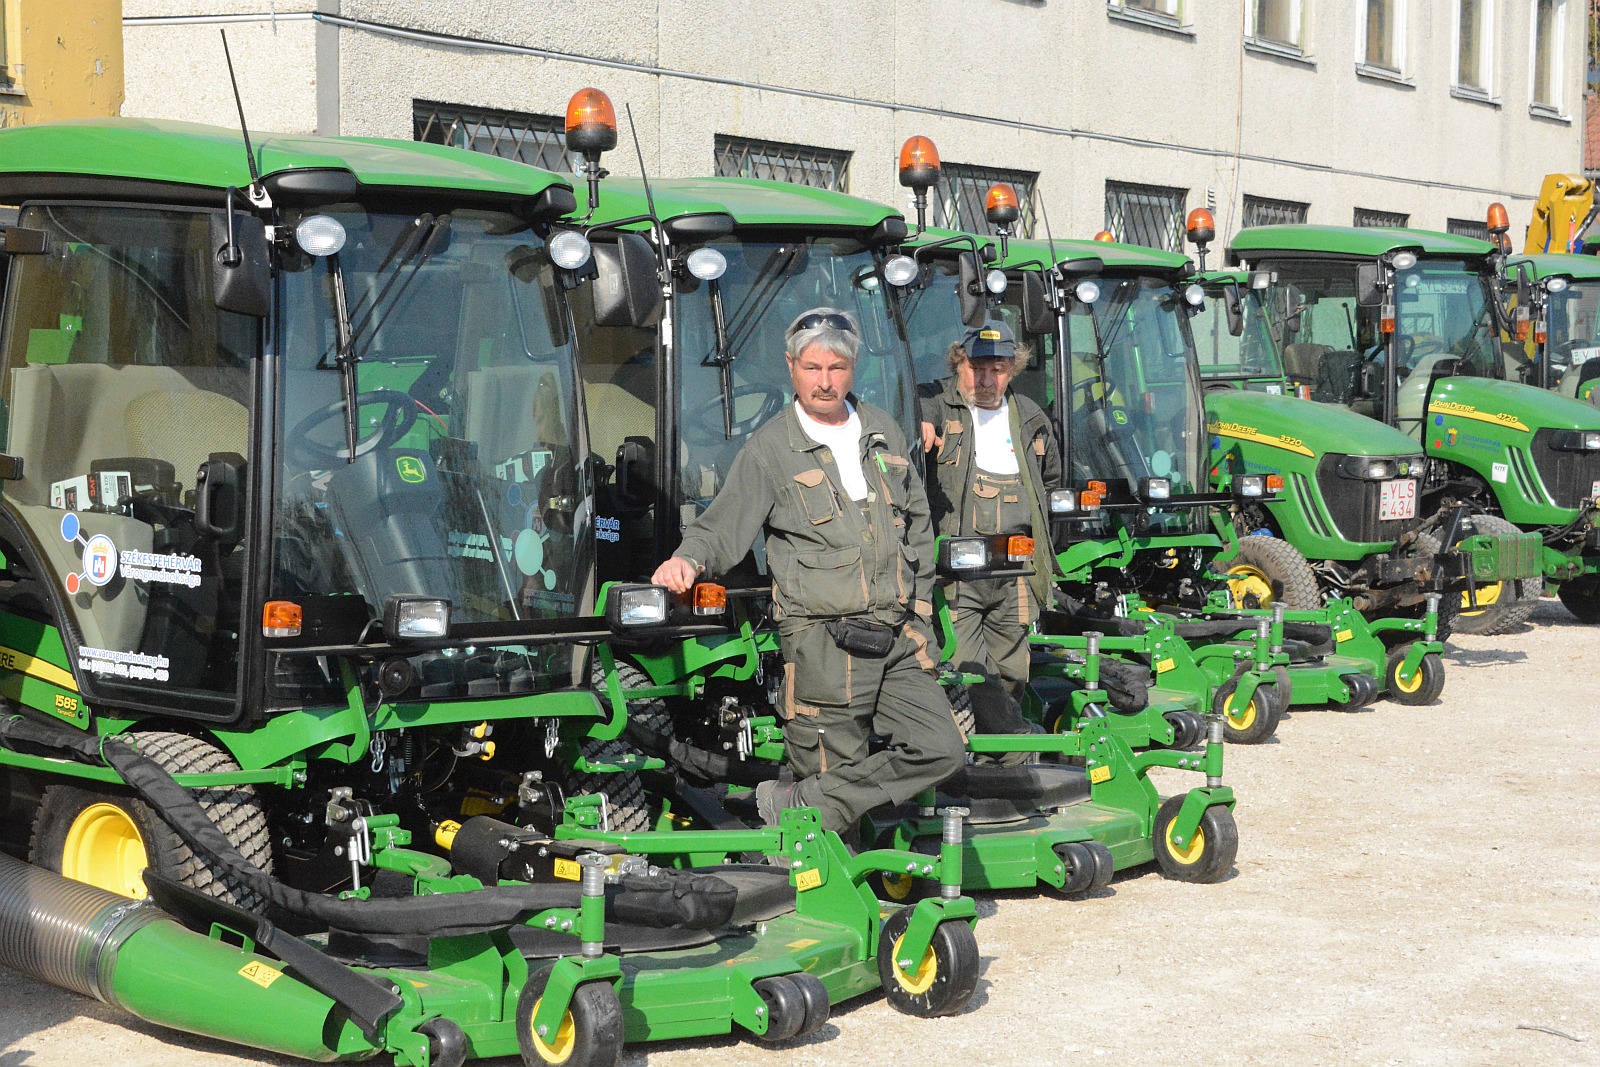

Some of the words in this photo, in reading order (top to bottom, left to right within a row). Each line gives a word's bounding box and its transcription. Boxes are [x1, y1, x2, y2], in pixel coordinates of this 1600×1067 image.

[1450, 402, 1475, 413] DEERE
[1496, 412, 1518, 423] 4720
[1231, 423, 1258, 435] DEERE
[1279, 434, 1302, 447] 3320
[1390, 482, 1414, 499] YLS
[1390, 500, 1412, 517] 434
[121, 549, 201, 572] SZÉKESFEHÉRVÁR
[120, 565, 201, 587] Városgondnoksága
[80, 647, 169, 667] www.varosgondnoksag.hu
[55, 694, 78, 711] 1585
